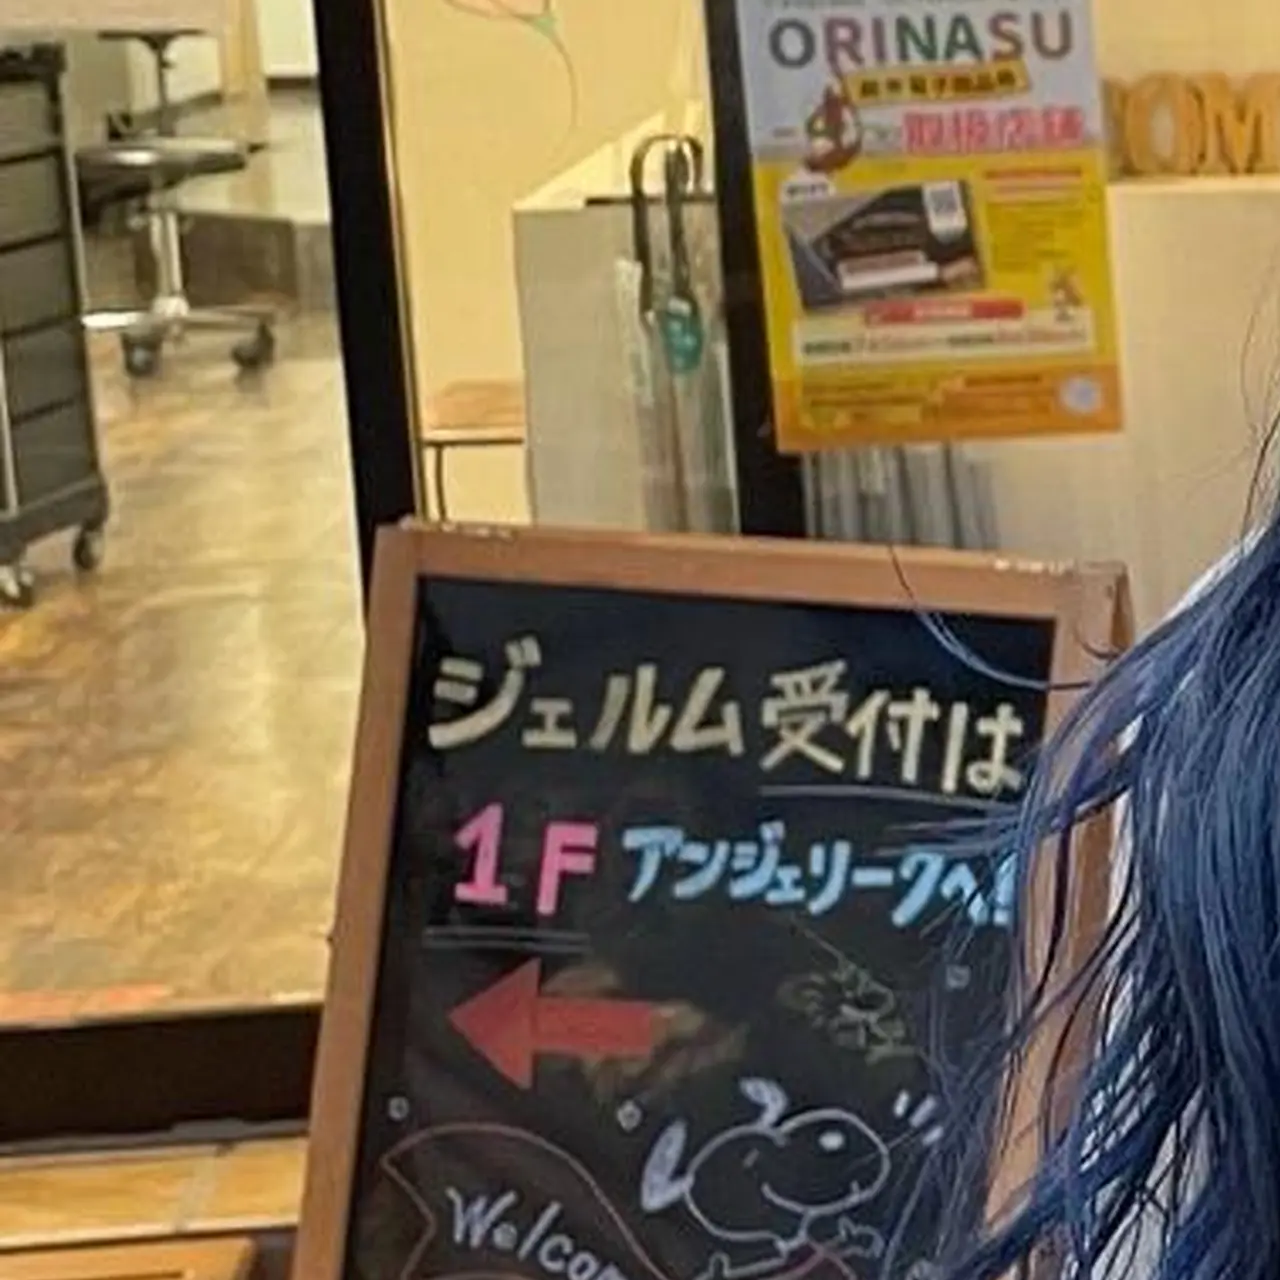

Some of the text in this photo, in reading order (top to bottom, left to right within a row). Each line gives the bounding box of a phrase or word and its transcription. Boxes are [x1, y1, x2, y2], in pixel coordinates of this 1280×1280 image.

[768, 9, 1073, 69] ORINASU
[428, 634, 1024, 794] ジェルム受付は
[455, 802, 598, 916] 1F
